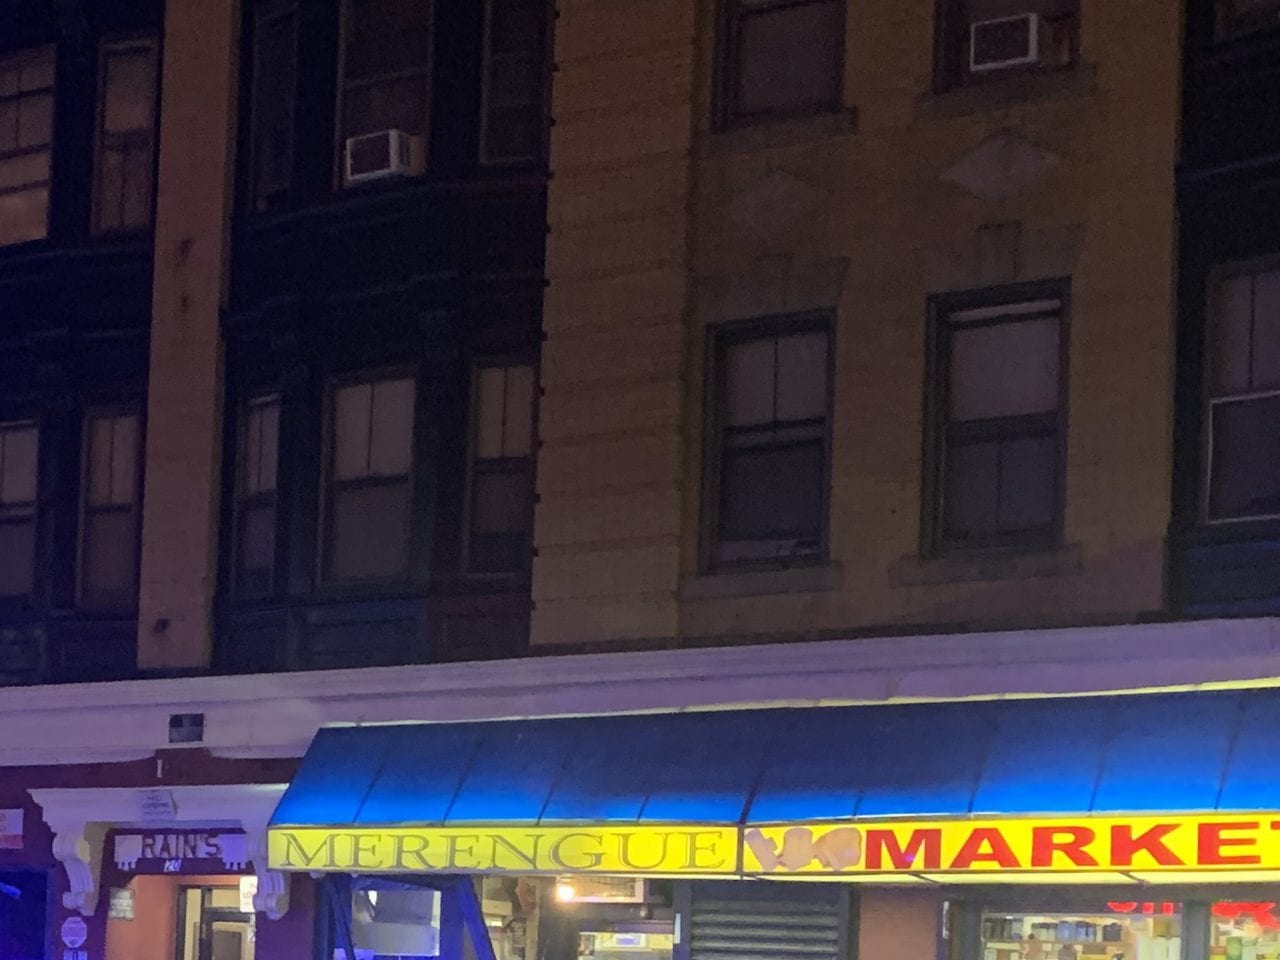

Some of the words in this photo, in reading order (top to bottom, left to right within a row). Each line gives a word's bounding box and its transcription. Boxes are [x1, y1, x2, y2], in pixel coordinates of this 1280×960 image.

[141, 833, 221, 858] RAIN'S
[280, 830, 726, 871] MERENGUE
[864, 821, 1280, 869] MARKE
